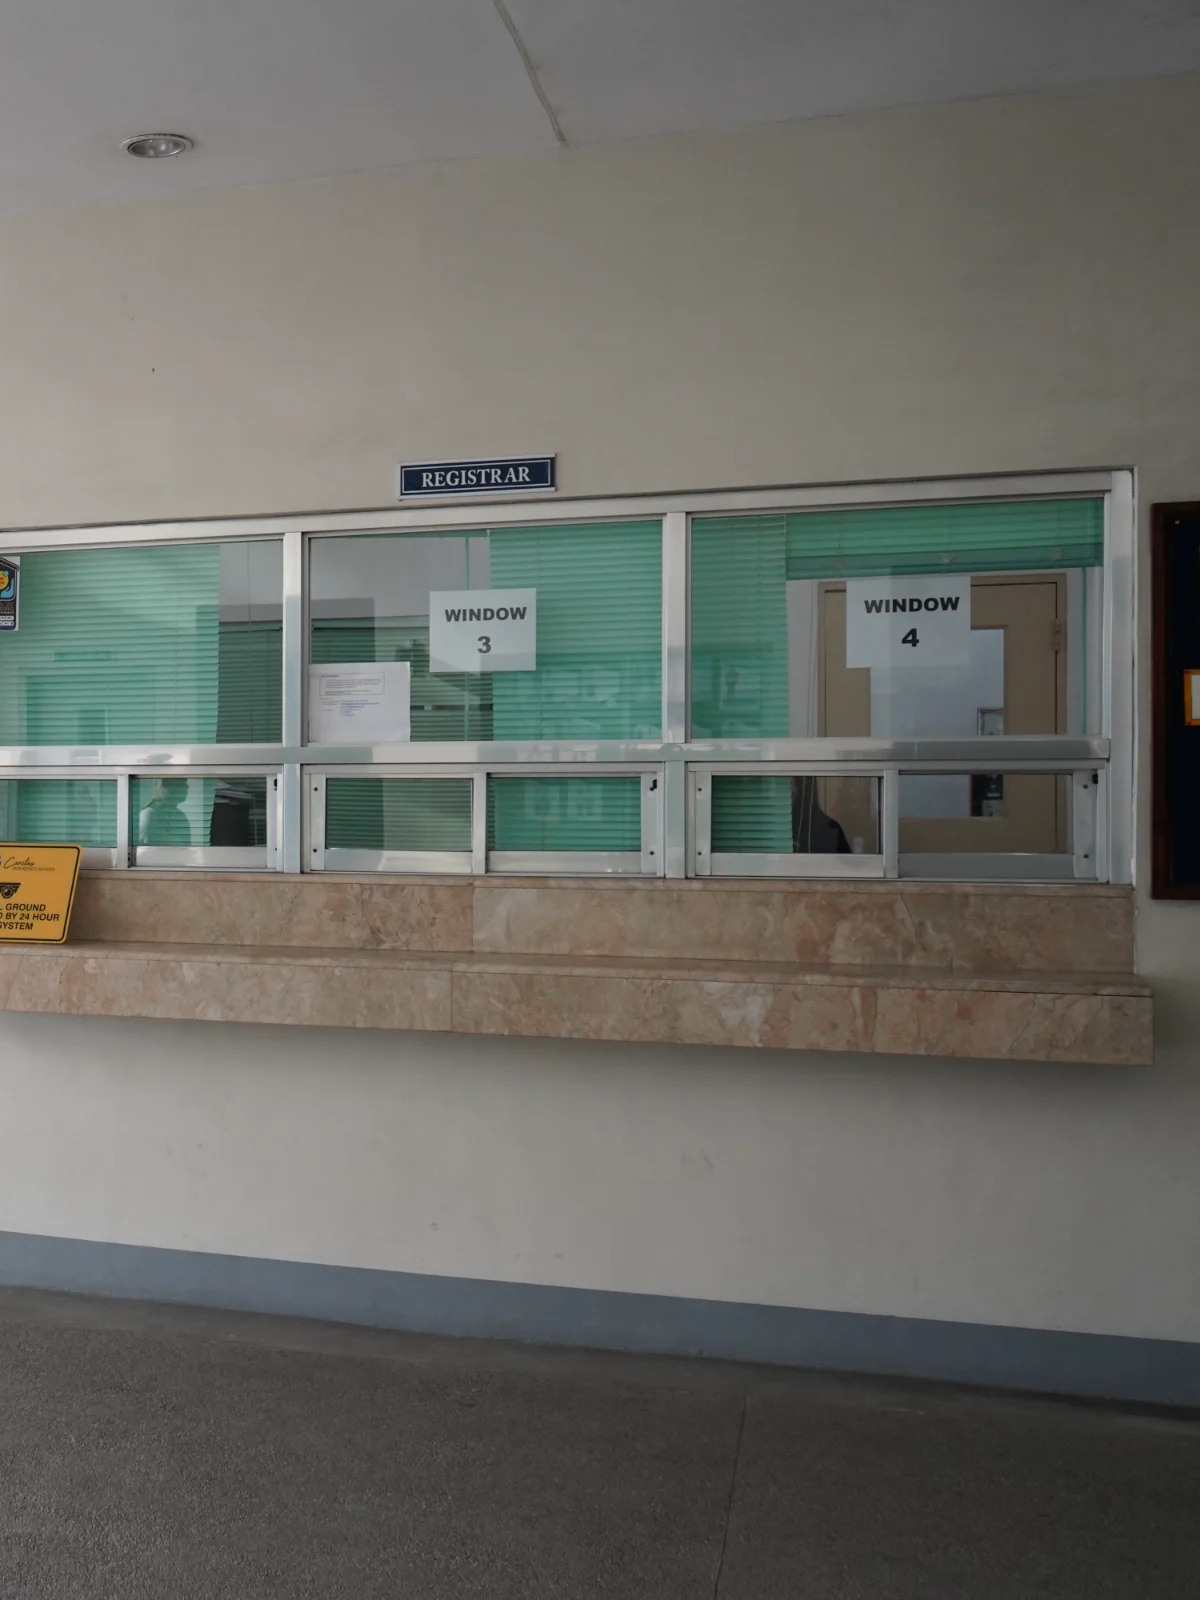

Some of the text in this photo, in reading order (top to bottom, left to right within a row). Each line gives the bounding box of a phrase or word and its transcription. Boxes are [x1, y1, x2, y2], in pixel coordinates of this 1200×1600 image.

[421, 466, 531, 488] REGISTRAR
[864, 597, 960, 613] WINDOW
[445, 607, 527, 622] WINDOW
[477, 636, 492, 654] 3
[901, 628, 920, 647] 4
[3, 856, 35, 869] Caritas
[5, 903, 46, 912] GROUND
